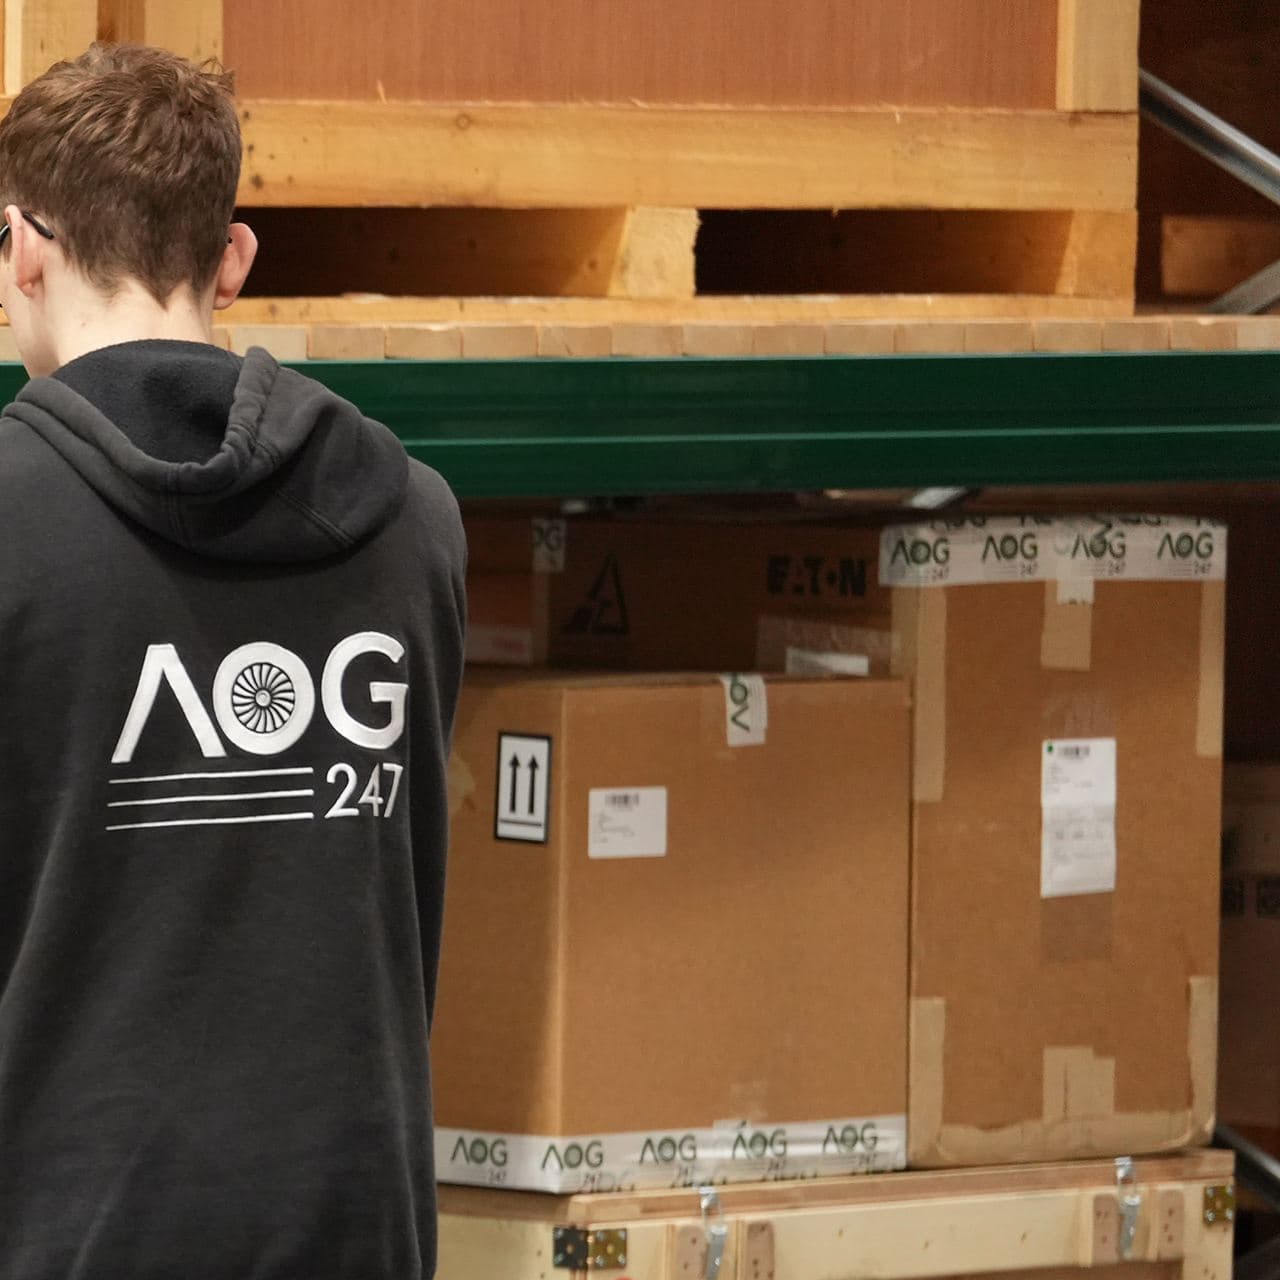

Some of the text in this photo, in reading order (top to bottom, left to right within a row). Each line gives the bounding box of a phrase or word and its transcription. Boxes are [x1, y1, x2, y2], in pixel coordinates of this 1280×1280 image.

[891, 537, 950, 566] AOG
[982, 532, 1038, 562] AOG
[1156, 532, 1214, 560] AOG
[111, 631, 410, 764] AOG
[324, 763, 404, 819] 247
[451, 1136, 508, 1167] AOG
[541, 1140, 604, 1171] AOG
[639, 1134, 698, 1165] AOG
